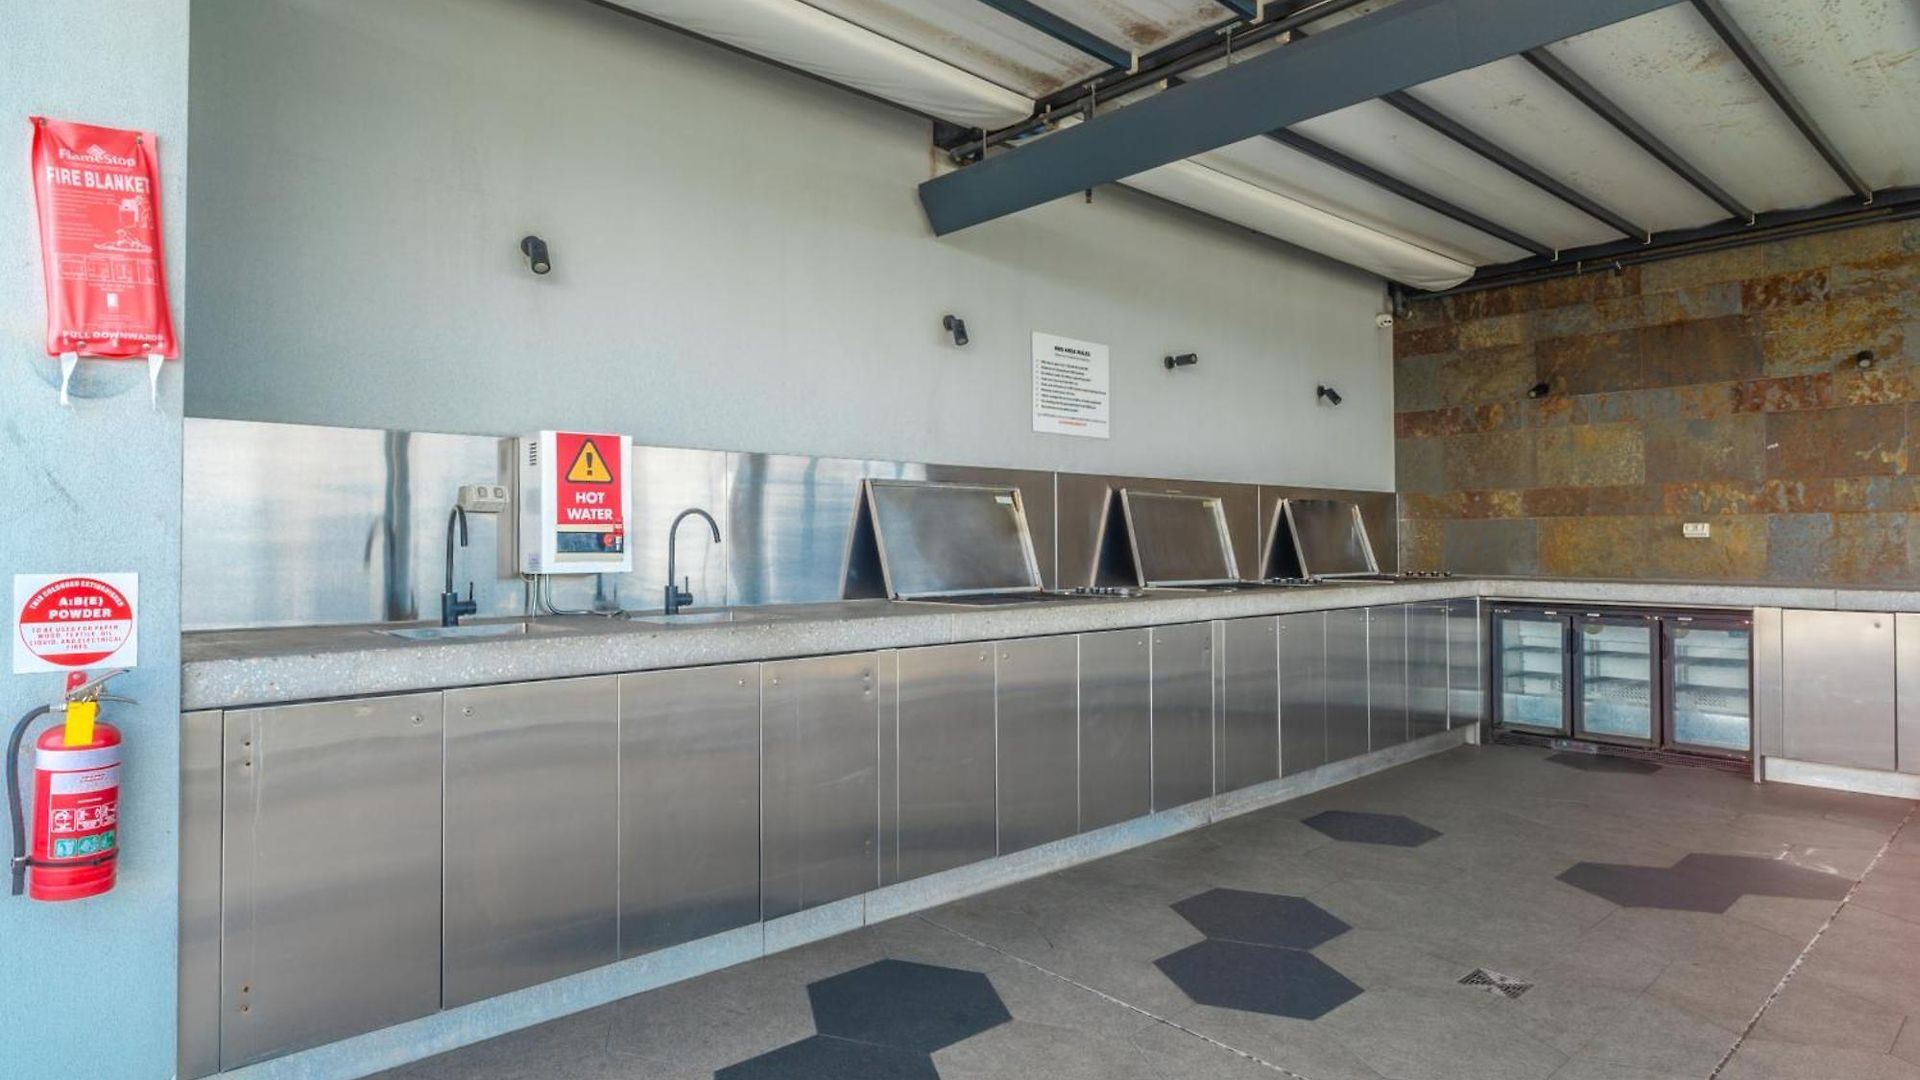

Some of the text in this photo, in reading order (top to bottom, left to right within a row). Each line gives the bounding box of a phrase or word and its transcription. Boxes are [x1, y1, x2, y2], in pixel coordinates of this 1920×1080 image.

[58, 147, 136, 168] FlameStop
[45, 165, 83, 187] FIRE
[83, 170, 151, 194] BLANKET
[62, 329, 164, 342] PULL DOWNWARDS
[575, 491, 606, 504] HOT
[566, 508, 614, 520] WATER
[48, 608, 112, 619] POWDER
